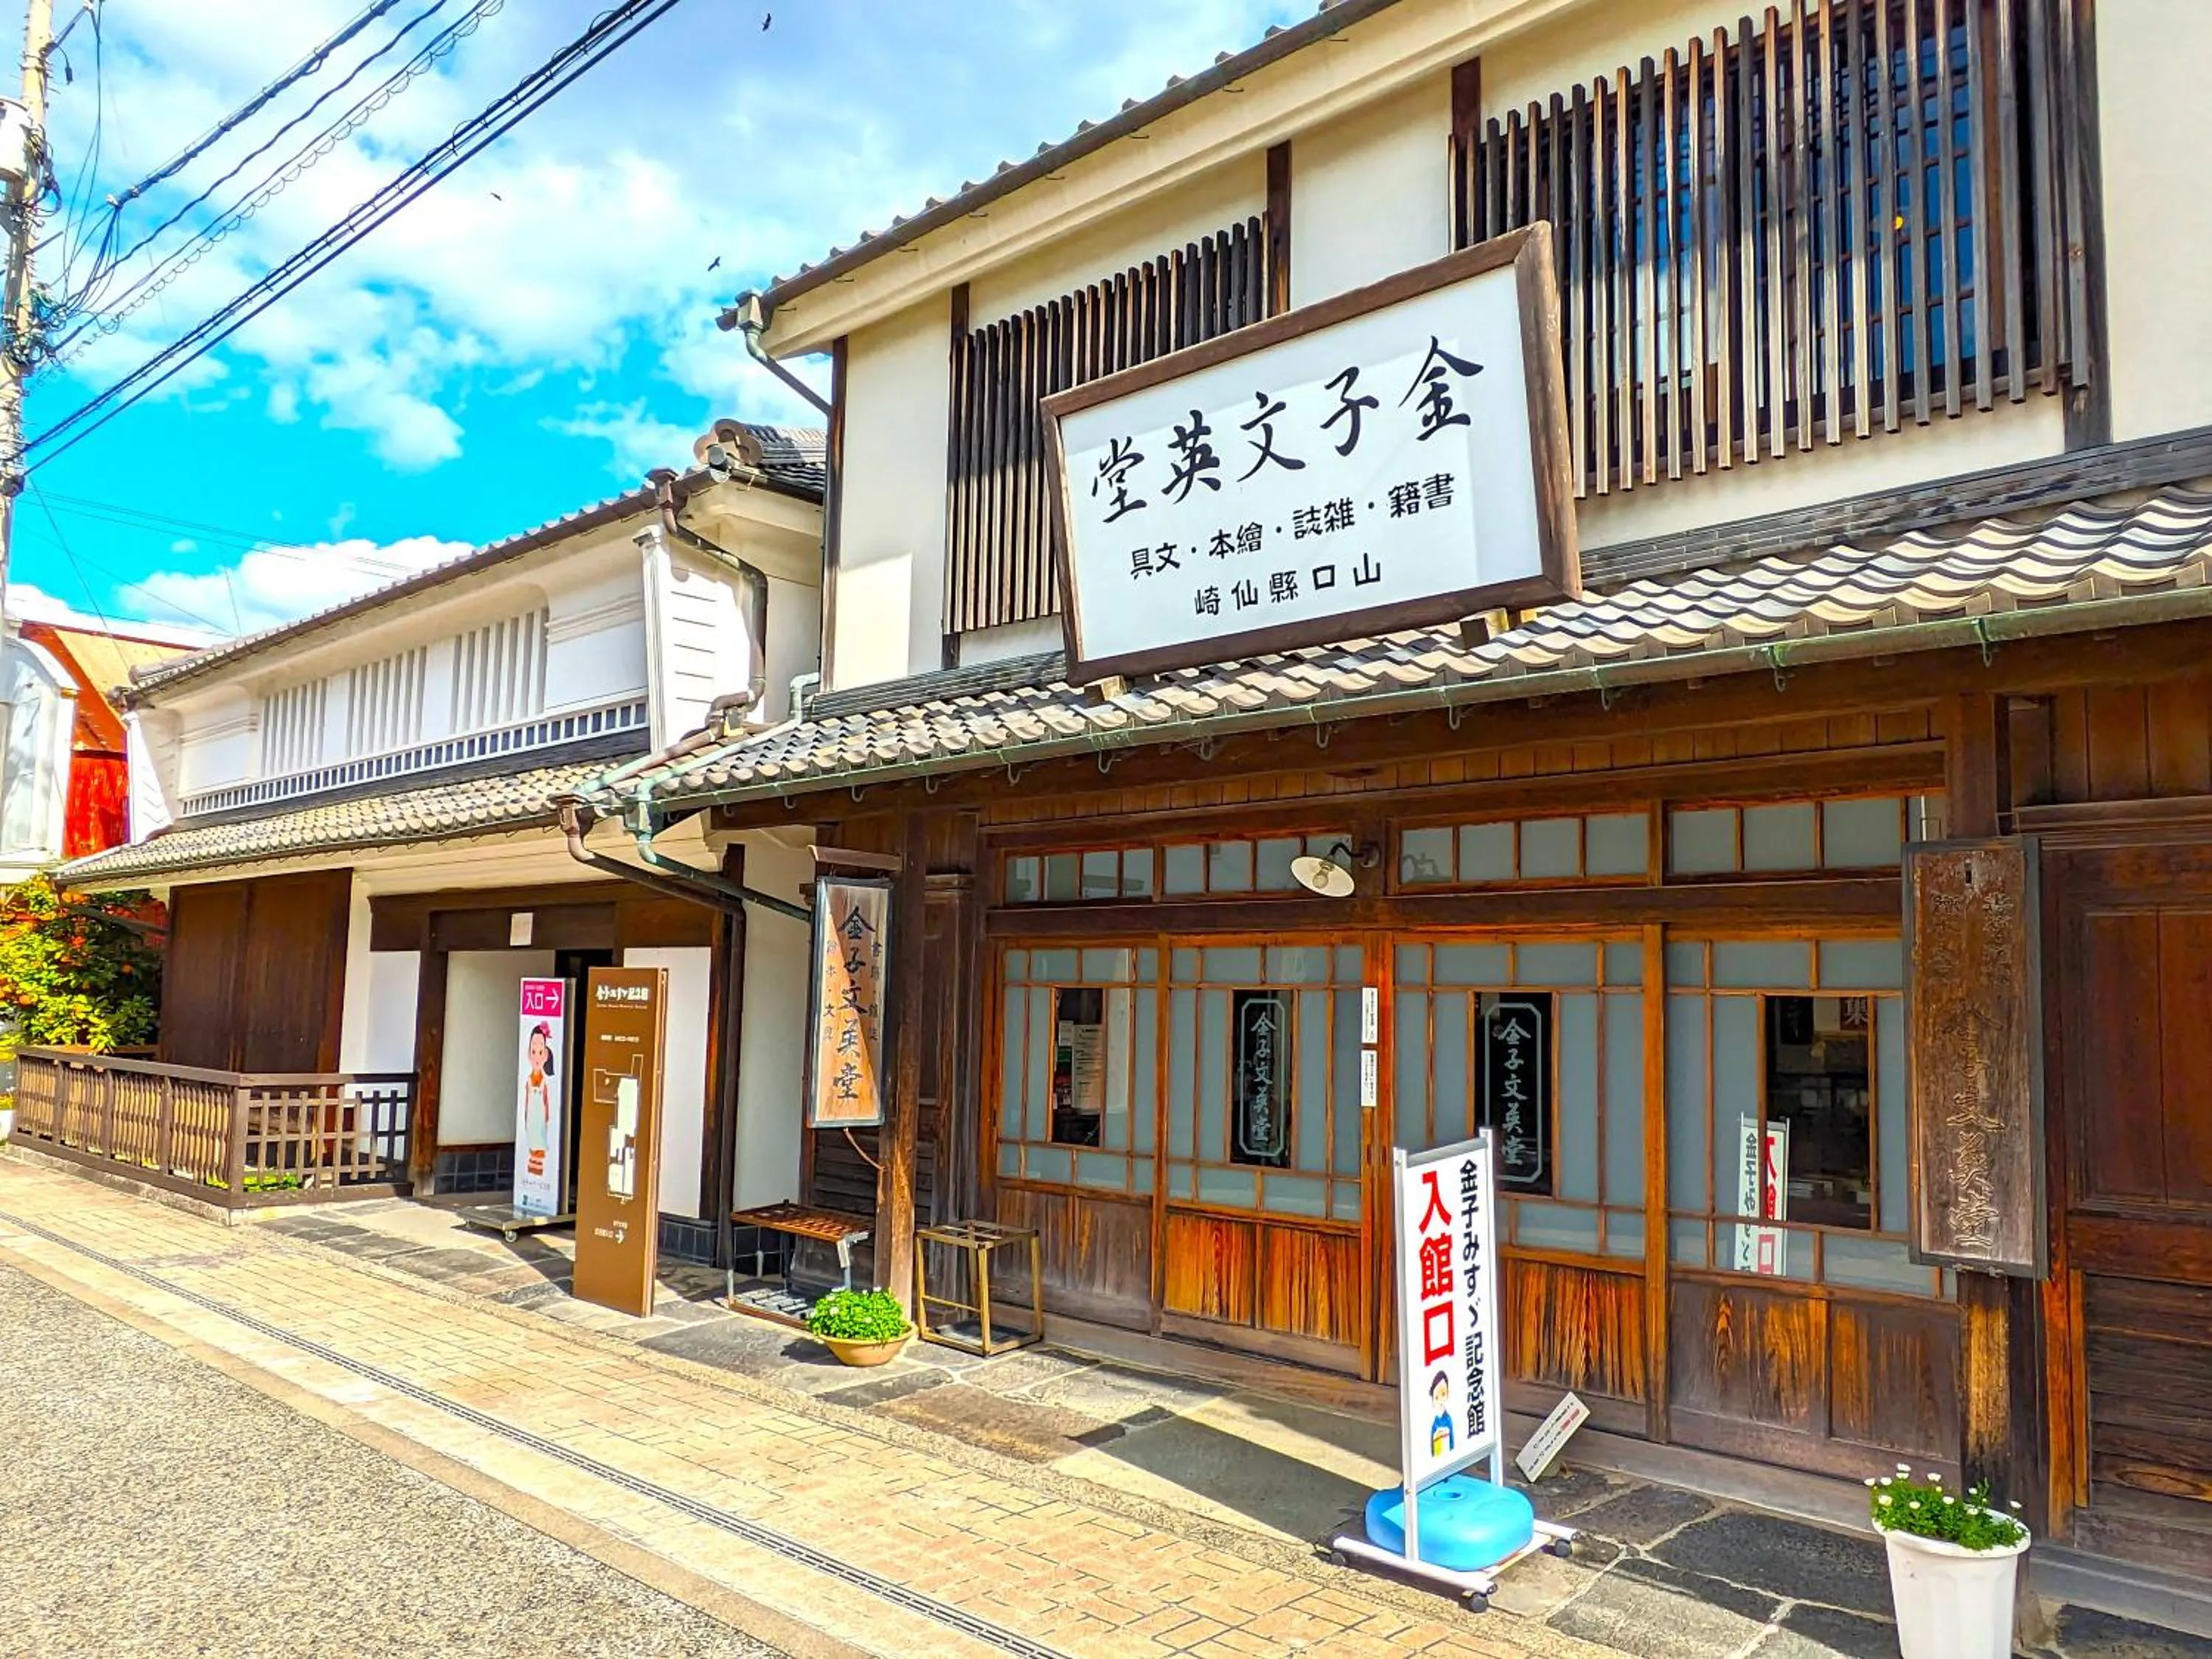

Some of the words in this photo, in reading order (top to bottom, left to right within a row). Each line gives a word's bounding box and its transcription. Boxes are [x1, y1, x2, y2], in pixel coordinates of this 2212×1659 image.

[1091, 335, 1484, 524] 金子文英堂
[1194, 552, 1382, 616] 山口縣仙崎
[525, 992, 543, 1009] 入口
[833, 906, 875, 1099] 金子文英堂
[1251, 1012, 1278, 1142] 金子文英堂
[1498, 1018, 1531, 1165] 金子文英堂
[1418, 1171, 1454, 1366] 入館口
[1460, 1159, 1486, 1439] 金子みすゞ記念館
